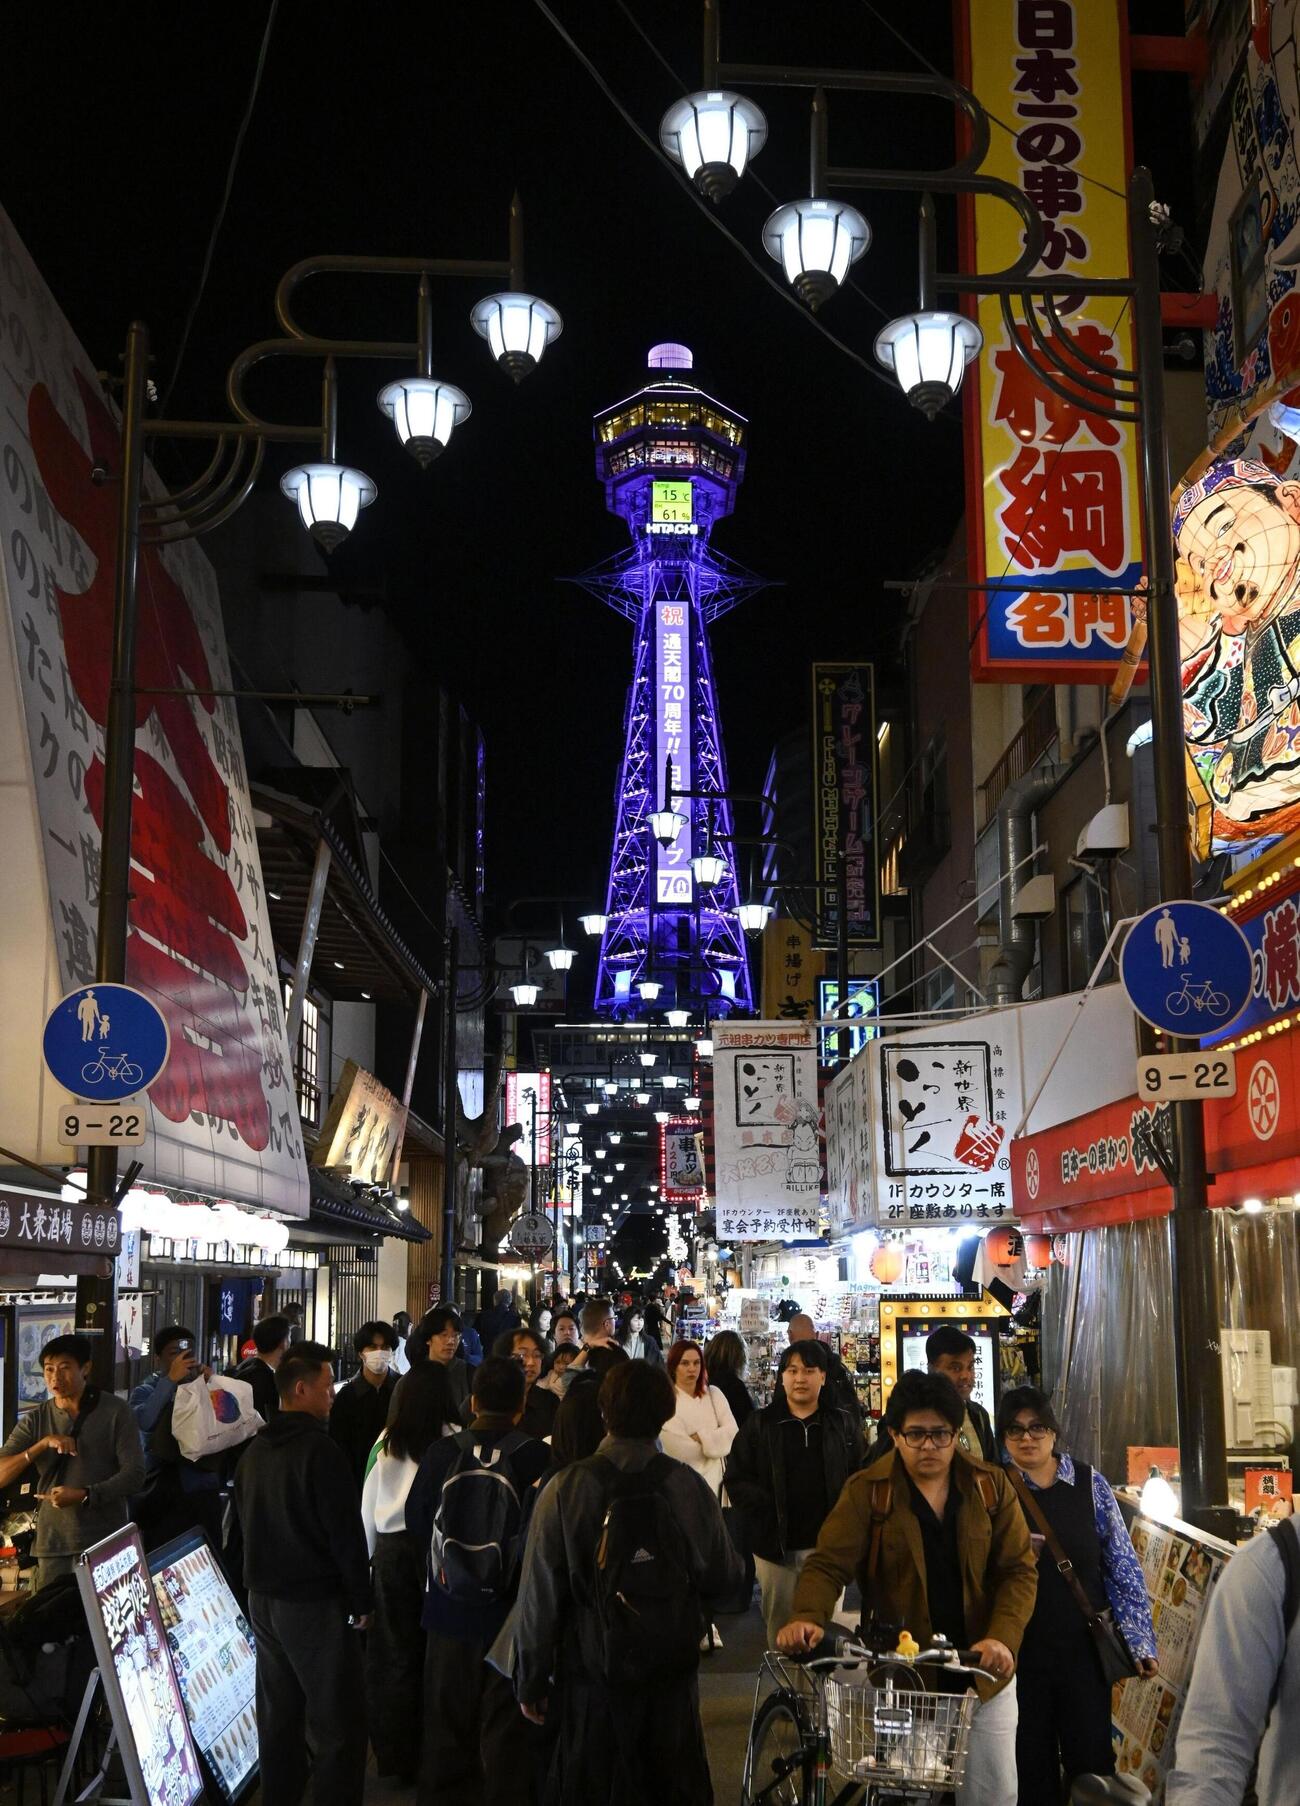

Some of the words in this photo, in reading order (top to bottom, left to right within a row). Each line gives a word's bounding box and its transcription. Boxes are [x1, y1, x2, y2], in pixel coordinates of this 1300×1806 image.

[994, 323, 1127, 572] 横綱
[663, 490, 677, 501] 15
[663, 510, 677, 520] 61
[646, 523, 699, 535] HITACHI
[661, 606, 684, 626] 祝
[1005, 590, 1130, 648] 名門
[784, 935, 802, 988] 串揚げ
[718, 1034, 812, 1047] 元祖串カツ専門店
[952, 1059, 979, 1113] 新世界
[909, 1182, 1006, 1199] カウンター席
[909, 1202, 1007, 1220] 座敷あります
[17, 1201, 74, 1245] 大衆酒場
[721, 1218, 817, 1234] 宴会予約受付中
